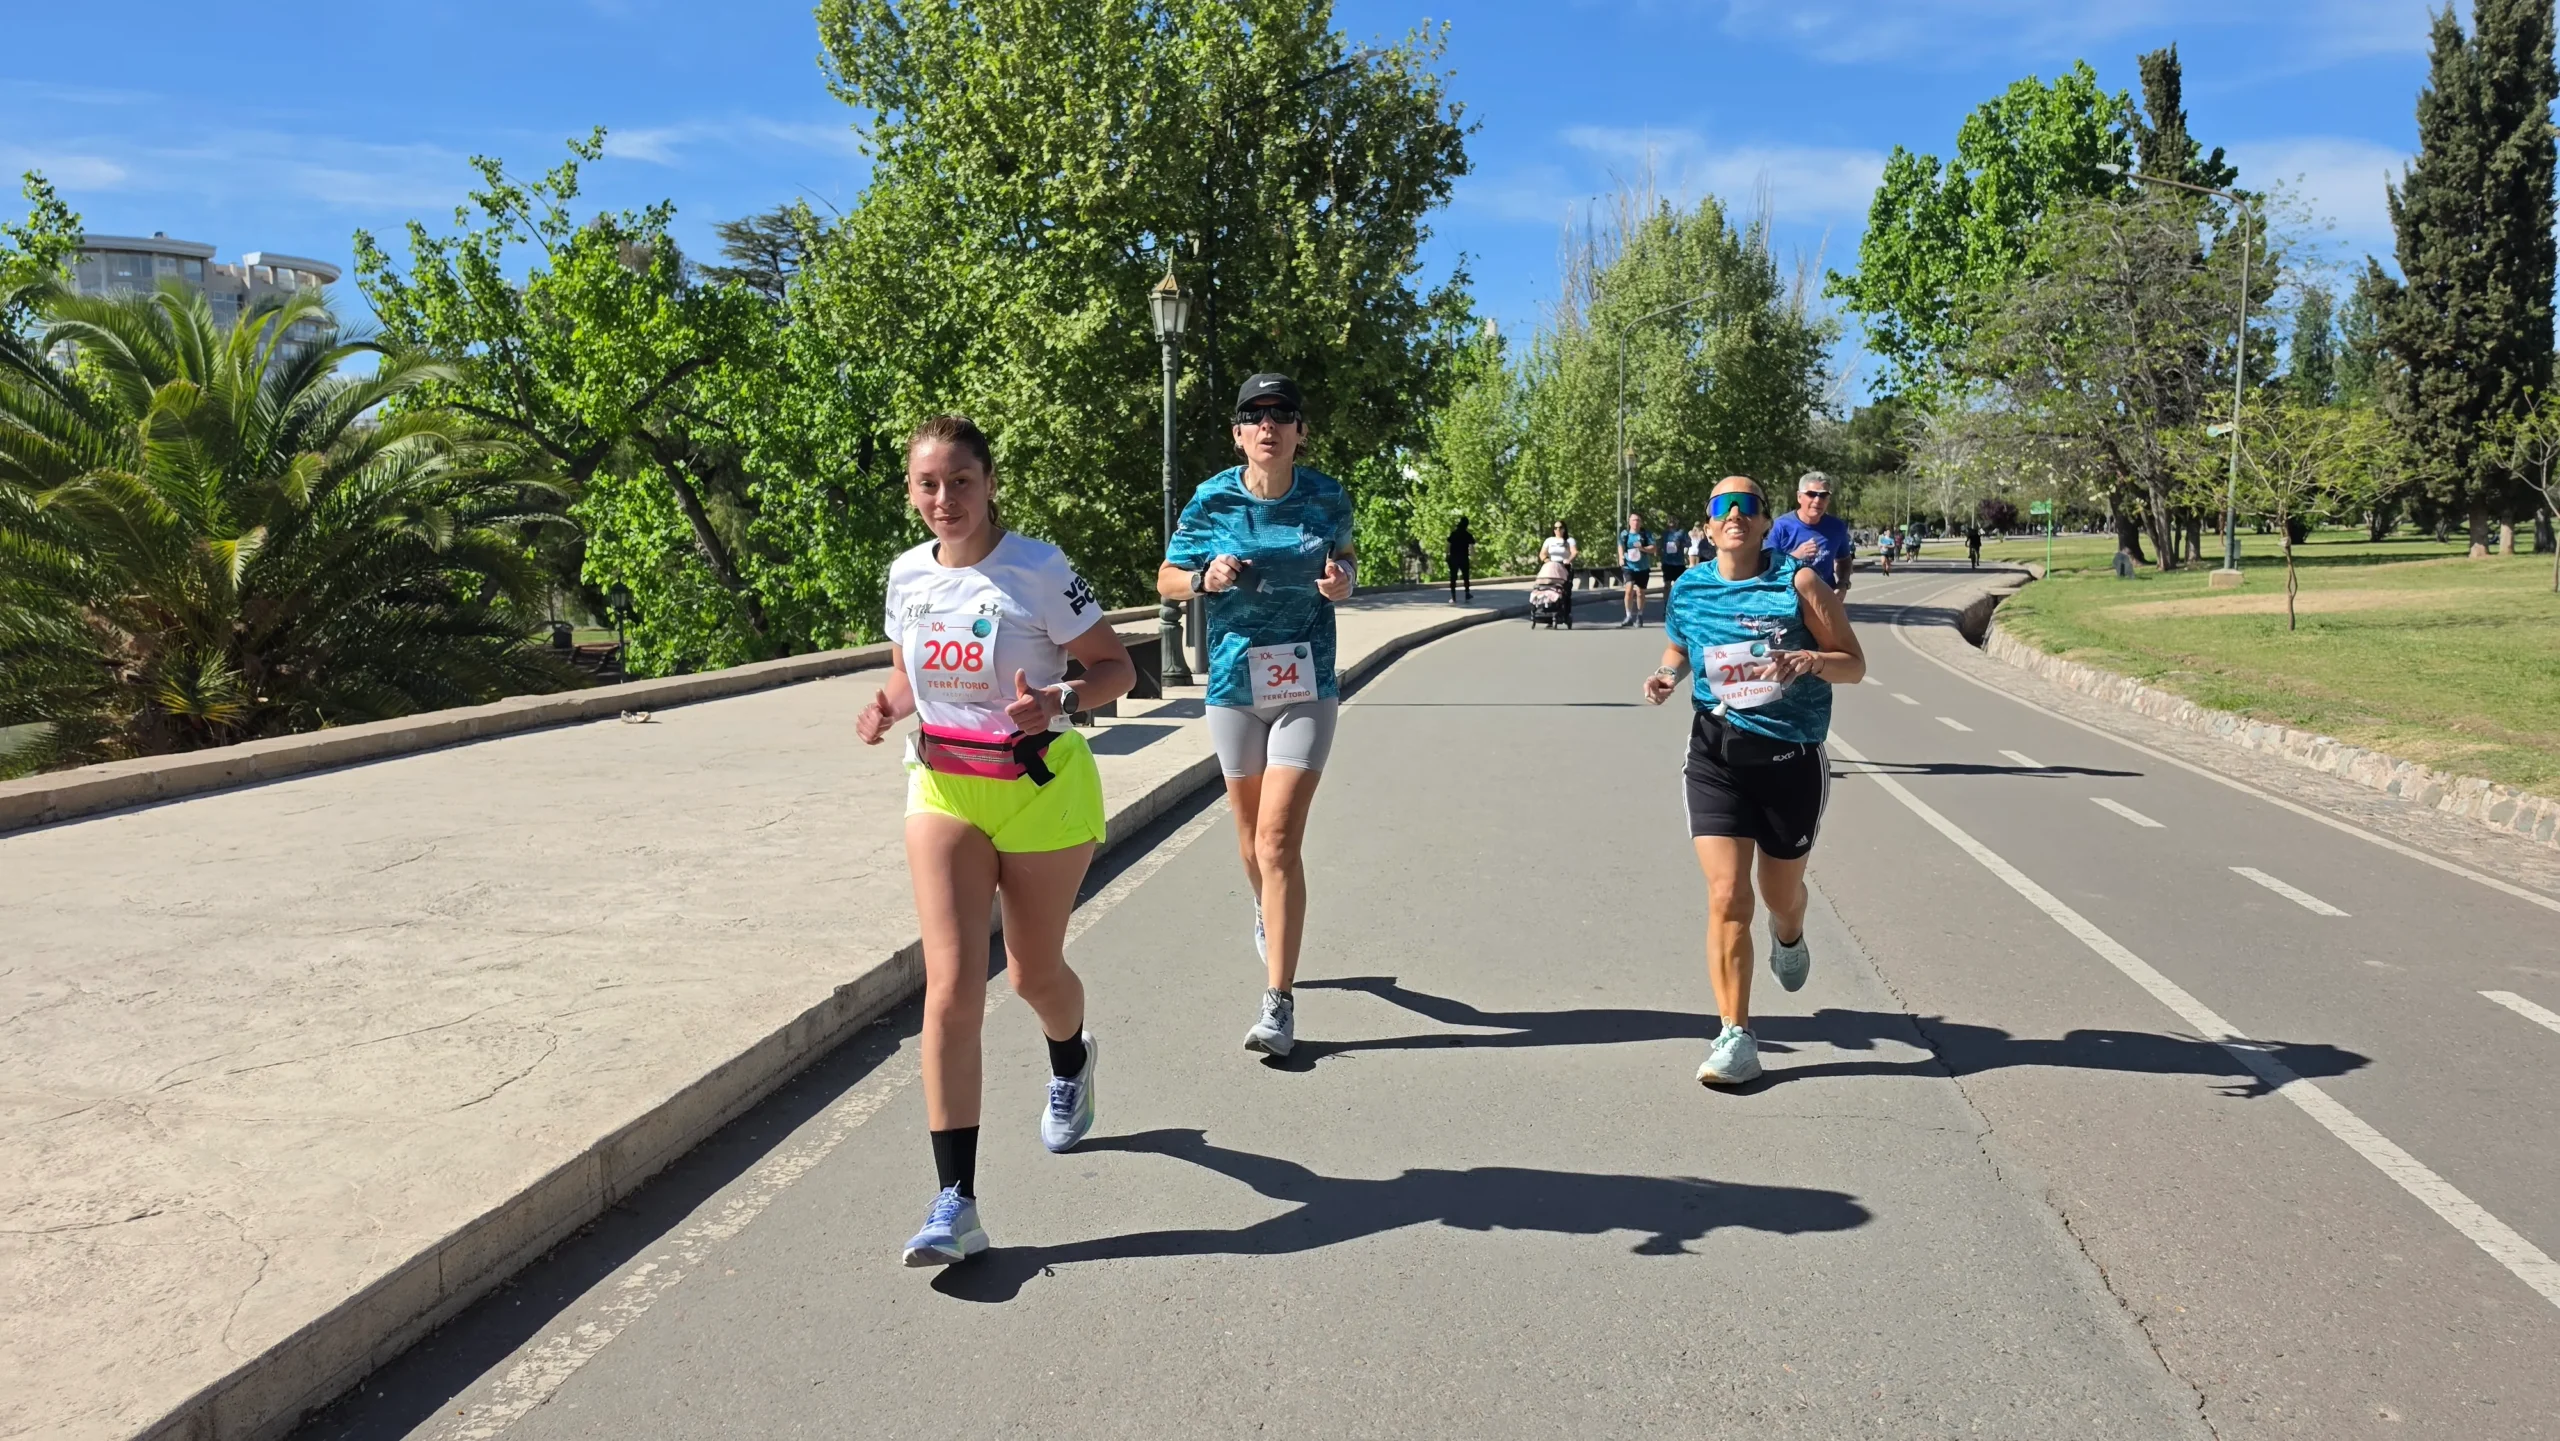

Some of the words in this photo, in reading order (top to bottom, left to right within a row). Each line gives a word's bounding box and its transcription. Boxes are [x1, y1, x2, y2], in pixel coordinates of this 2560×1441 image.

[931, 621, 945, 632] 10k
[921, 640, 984, 672] 208
[1267, 663, 1299, 687] 34
